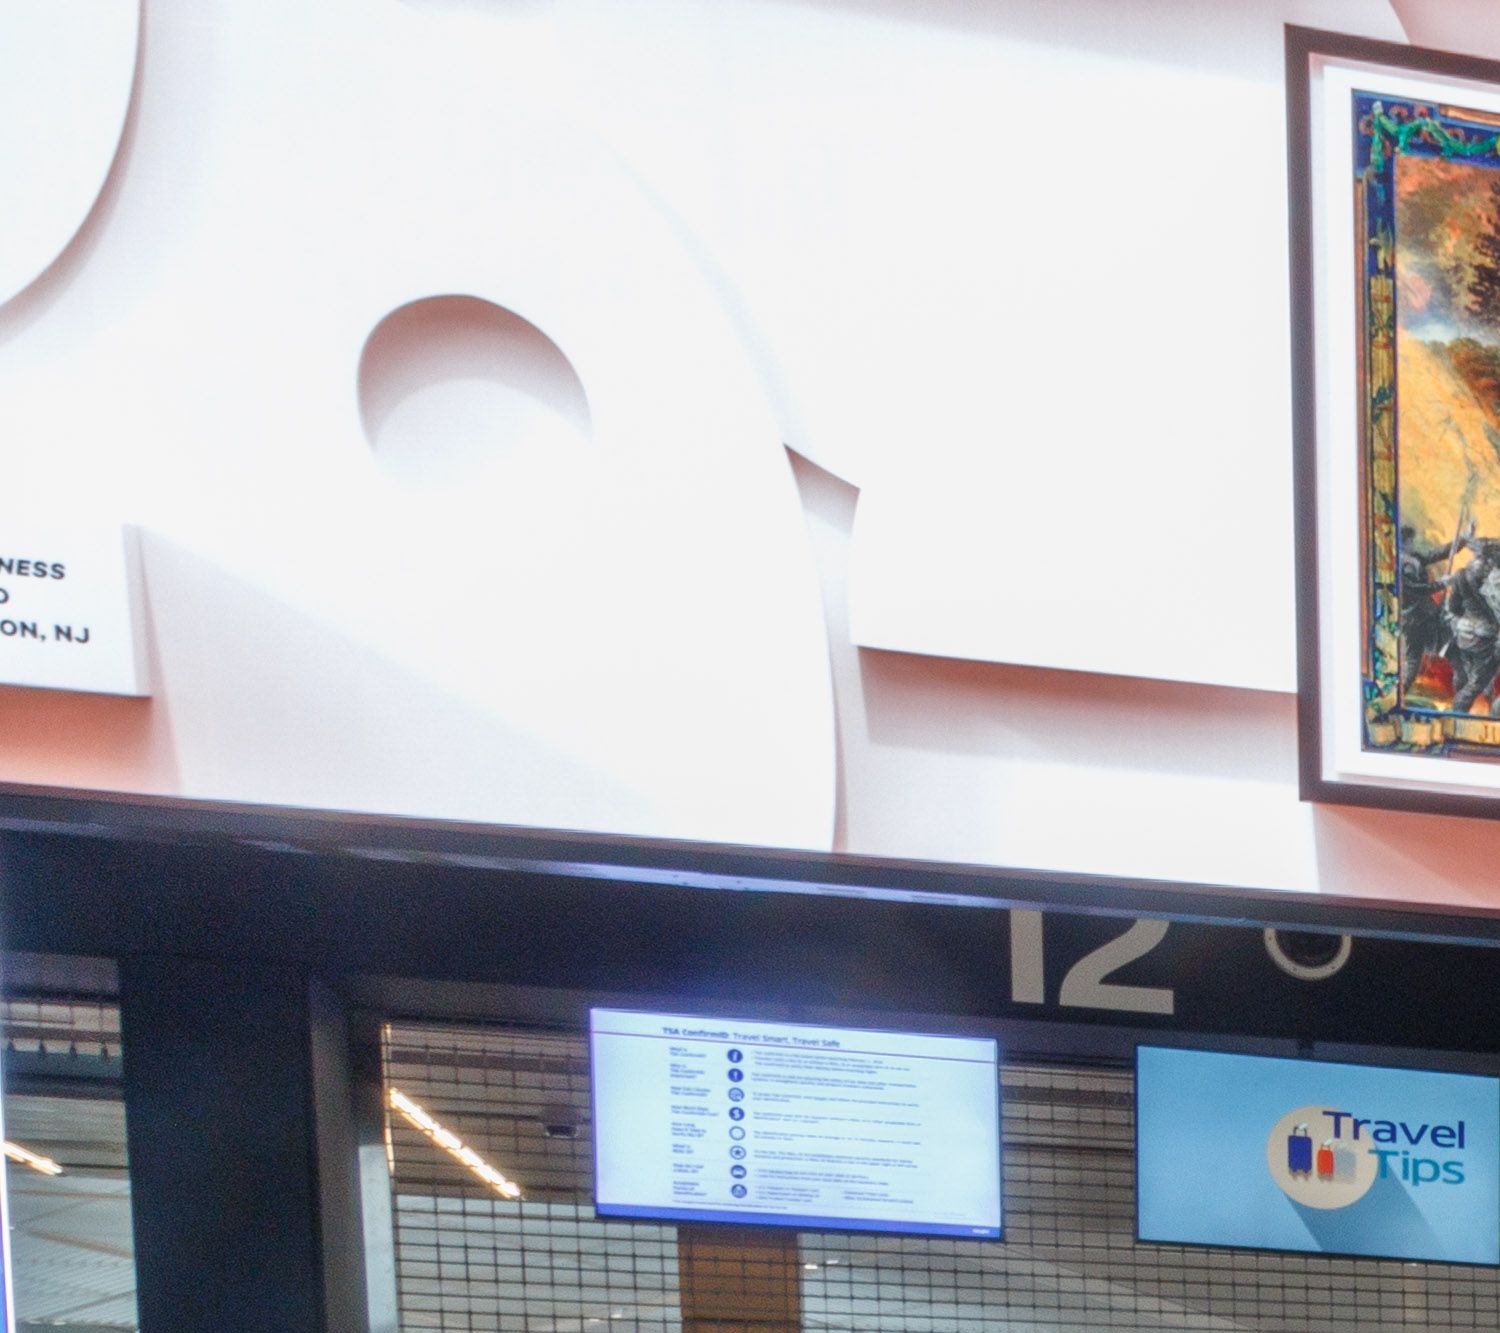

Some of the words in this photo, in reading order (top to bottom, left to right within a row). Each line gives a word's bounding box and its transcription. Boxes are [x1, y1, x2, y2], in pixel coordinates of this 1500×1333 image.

[54, 624, 90, 644] NJ
[1010, 908, 1174, 1015] 12
[1322, 1110, 1465, 1150] Travel
[1368, 1149, 1466, 1187] Tips
